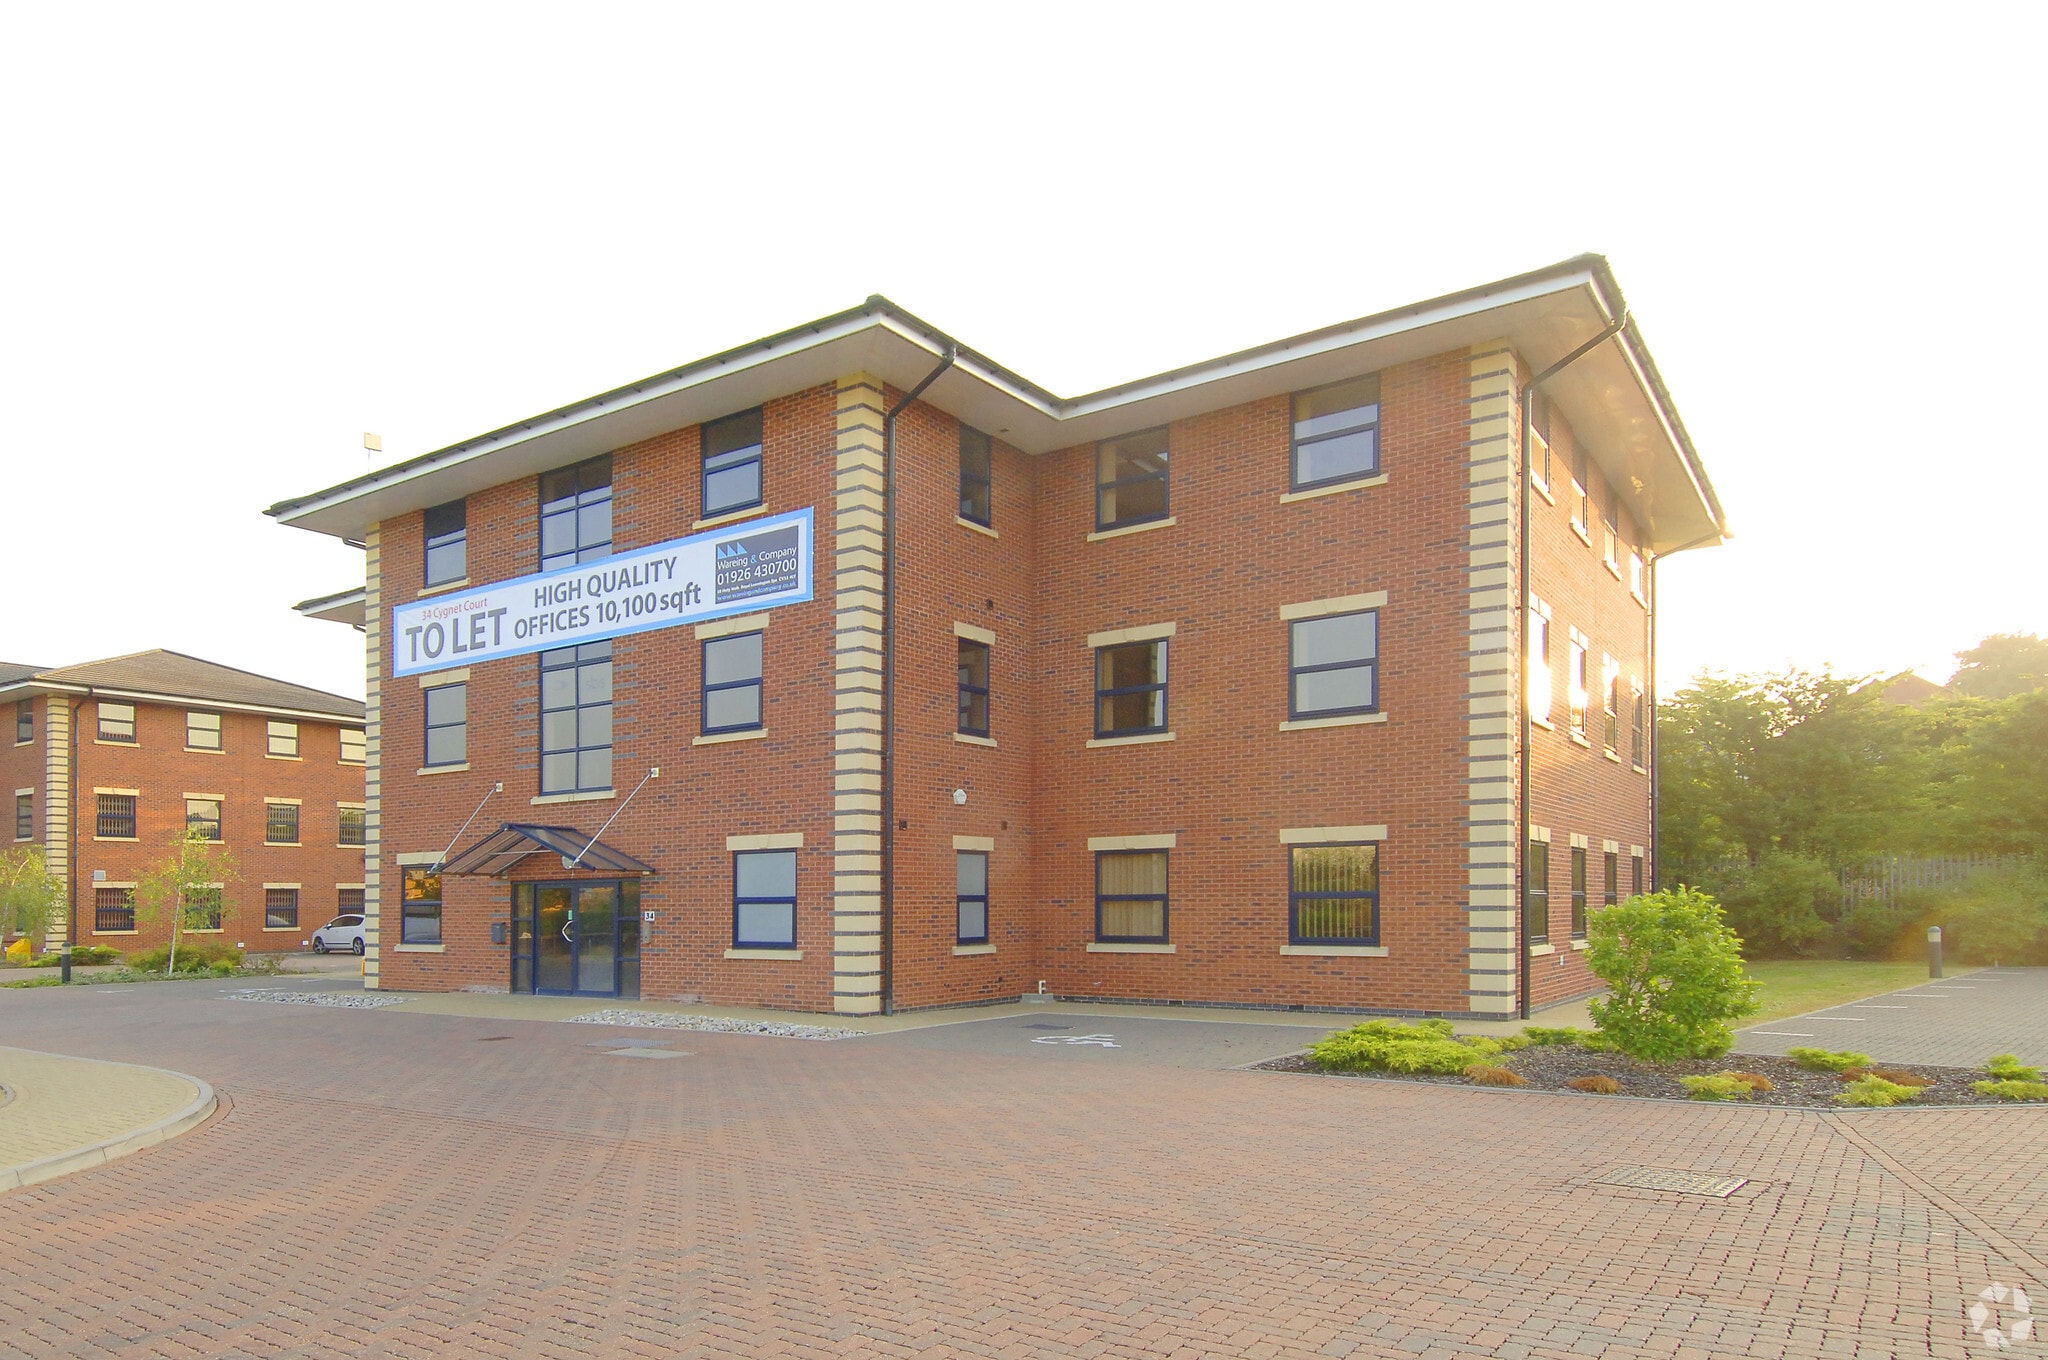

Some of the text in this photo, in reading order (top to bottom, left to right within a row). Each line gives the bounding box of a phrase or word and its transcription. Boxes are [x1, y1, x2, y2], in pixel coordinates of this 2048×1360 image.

[717, 547, 797, 570] Wareing & Company
[717, 558, 796, 585] 01926 430700
[534, 556, 677, 608] HIGH QUALITY
[422, 598, 488, 621] 34 Cygnet Court
[514, 581, 701, 639] OFFICES 10,100 sqft
[405, 607, 507, 662] TO LET
